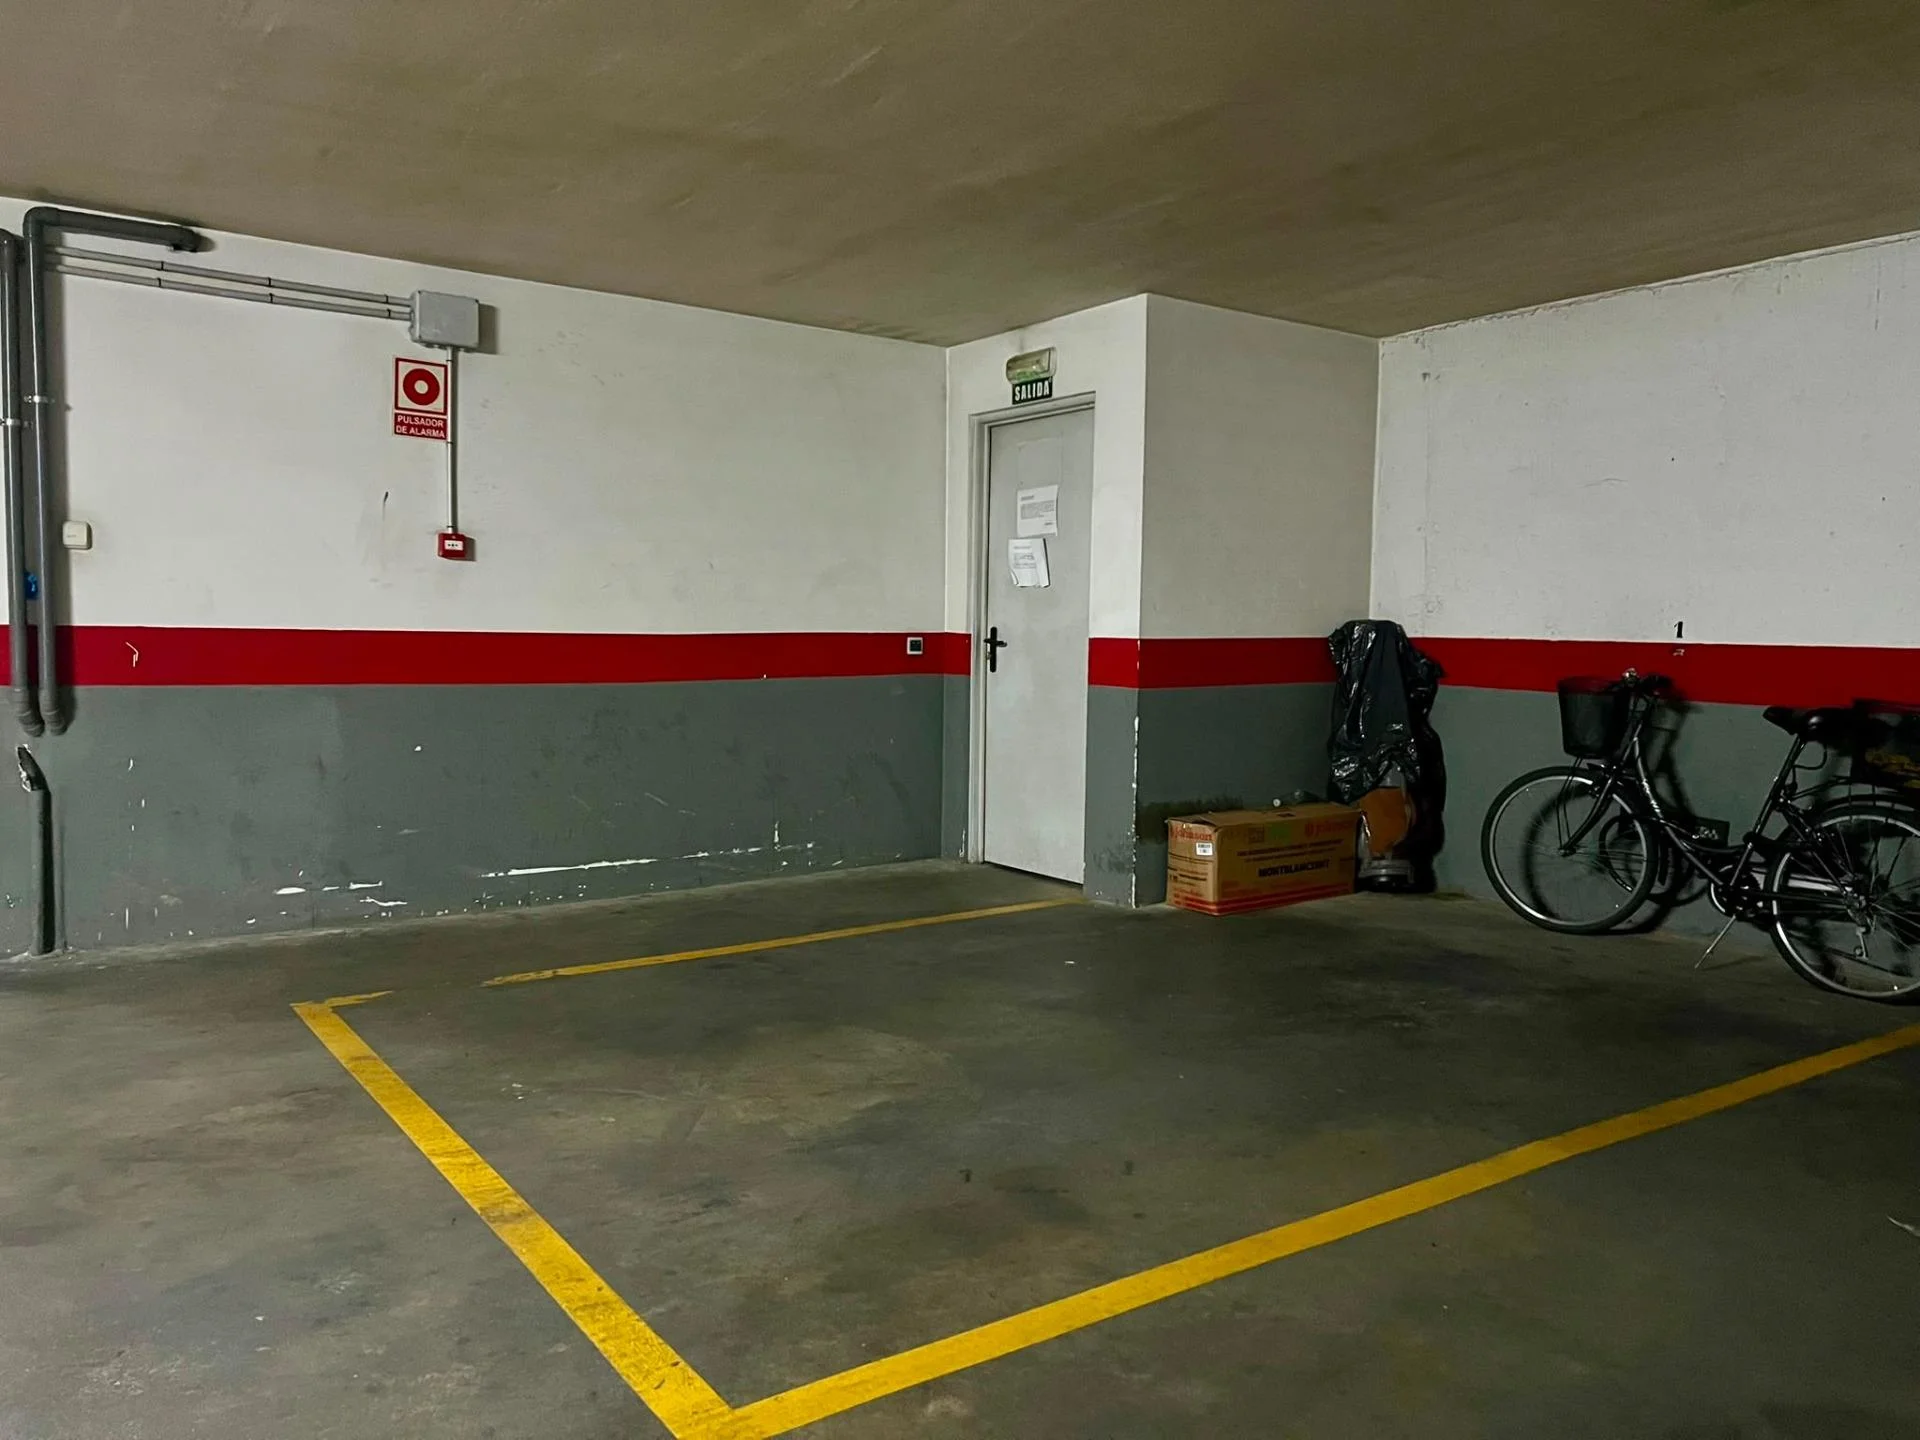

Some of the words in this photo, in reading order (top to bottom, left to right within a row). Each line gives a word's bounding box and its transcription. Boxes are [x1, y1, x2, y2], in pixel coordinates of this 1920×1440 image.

[1014, 380, 1050, 401] SALIDA
[397, 415, 444, 427] PULSADOR
[396, 425, 408, 434] DE
[409, 427, 445, 438] ALARMA
[1673, 620, 1684, 639] 1
